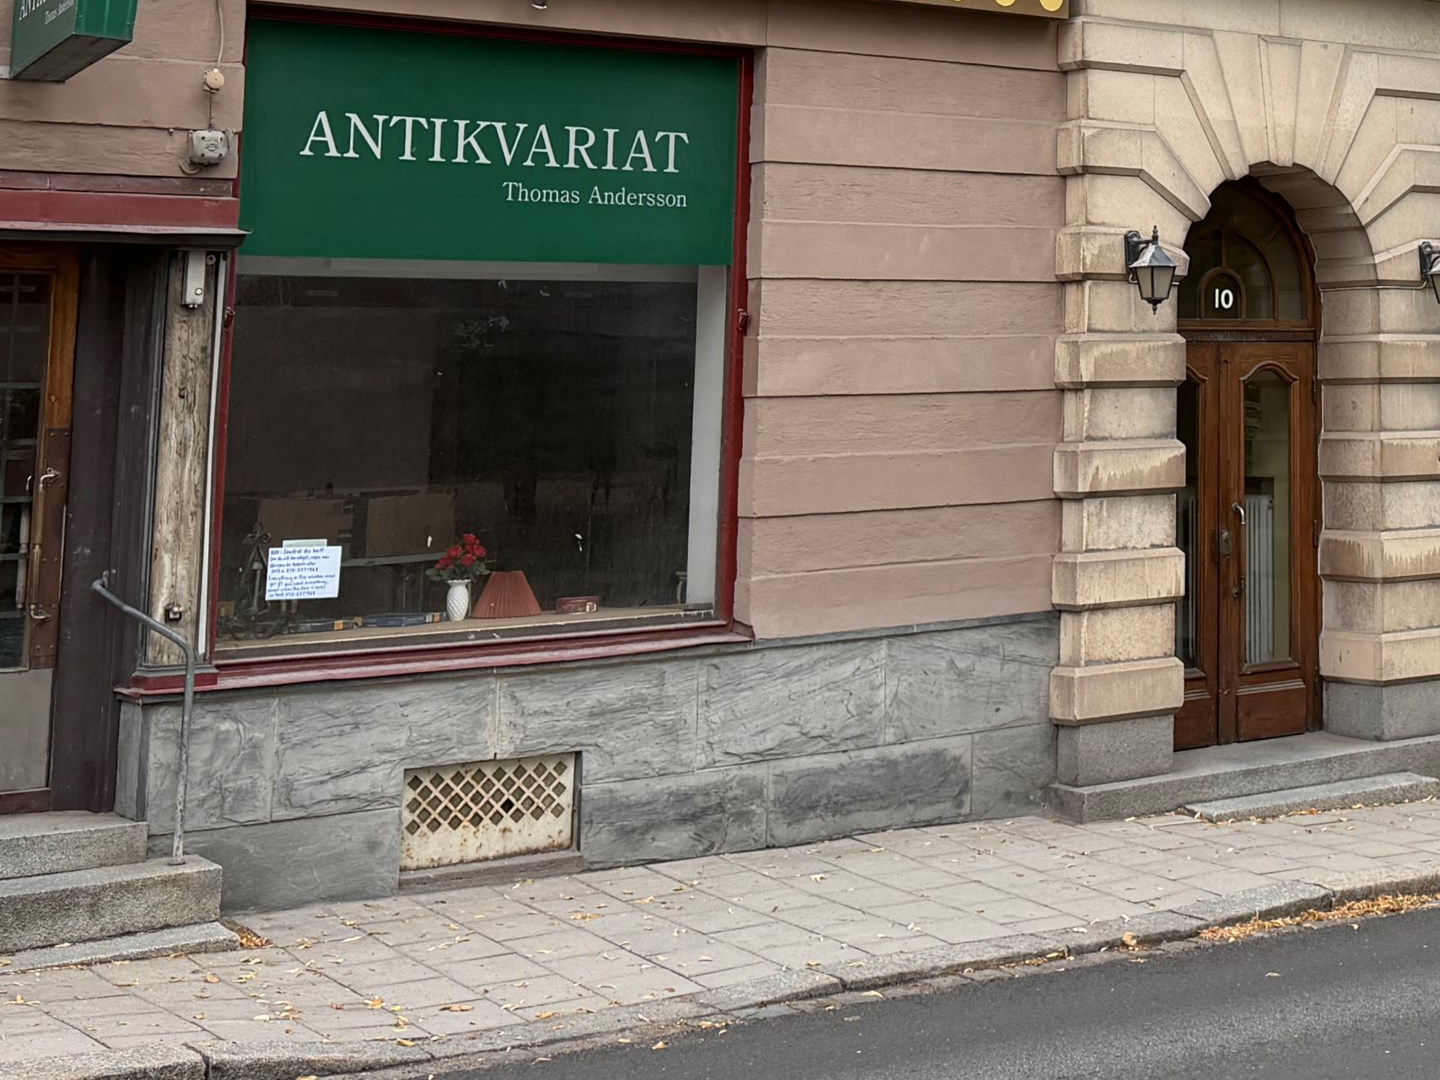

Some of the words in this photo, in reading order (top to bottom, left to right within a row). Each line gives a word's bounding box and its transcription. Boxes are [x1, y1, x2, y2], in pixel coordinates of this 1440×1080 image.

[299, 110, 689, 173] ANTIKVARIAT
[502, 181, 580, 204] Thomas
[588, 185, 687, 207] Andersson
[1214, 288, 1234, 309] 10
